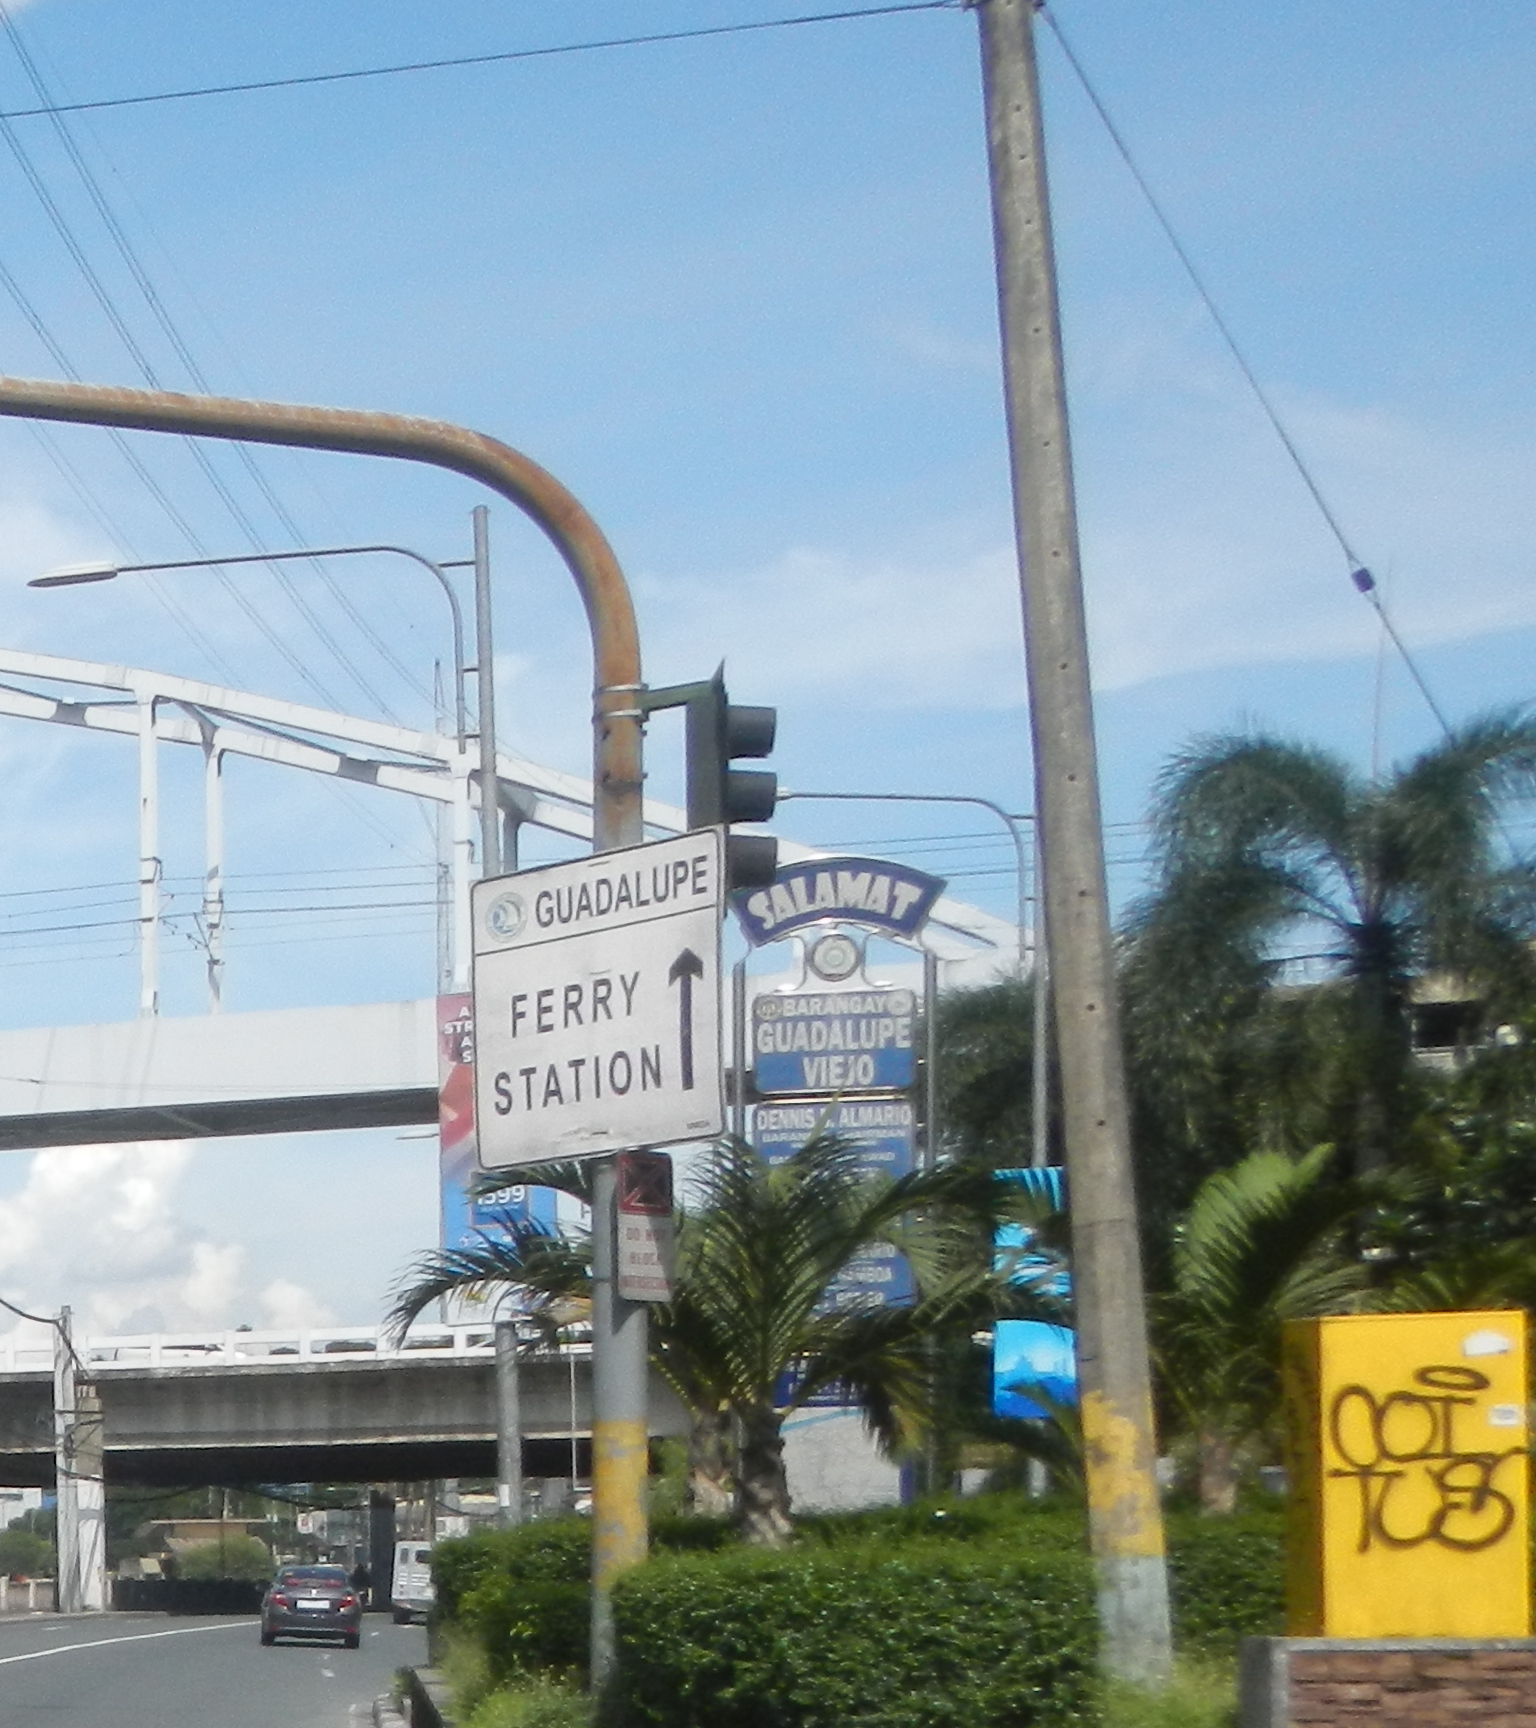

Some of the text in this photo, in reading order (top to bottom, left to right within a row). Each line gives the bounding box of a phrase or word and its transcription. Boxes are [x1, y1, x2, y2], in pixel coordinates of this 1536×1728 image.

[534, 854, 708, 929] GUADALUPE
[746, 870, 924, 931] SALAMAT
[510, 970, 641, 1038] FERRY
[781, 995, 888, 1017] BARANGAY
[756, 1017, 912, 1054] GUADALUPE
[493, 1044, 663, 1116] STATION
[802, 1053, 875, 1088] VIEJO
[756, 1108, 816, 1131] DENNIS
[838, 1104, 913, 1128] ALMARIO
